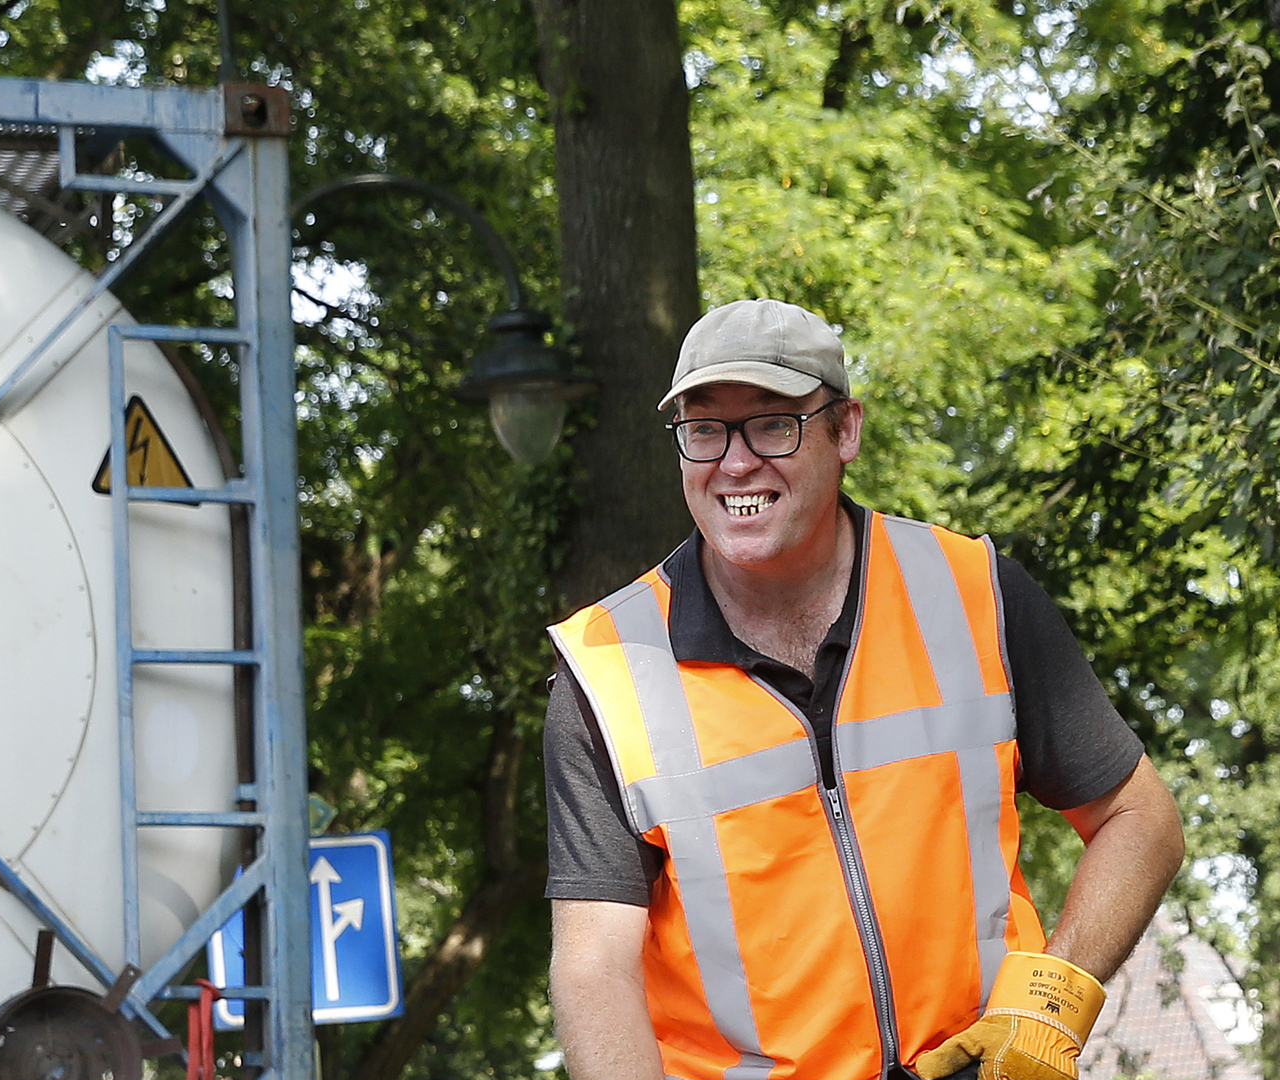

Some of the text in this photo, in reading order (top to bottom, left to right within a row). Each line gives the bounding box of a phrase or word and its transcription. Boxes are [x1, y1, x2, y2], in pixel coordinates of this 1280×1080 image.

[1032, 969, 1044, 978] 10
[1028, 989, 1061, 1003] WORKER
[1060, 998, 1079, 1014] COLD
